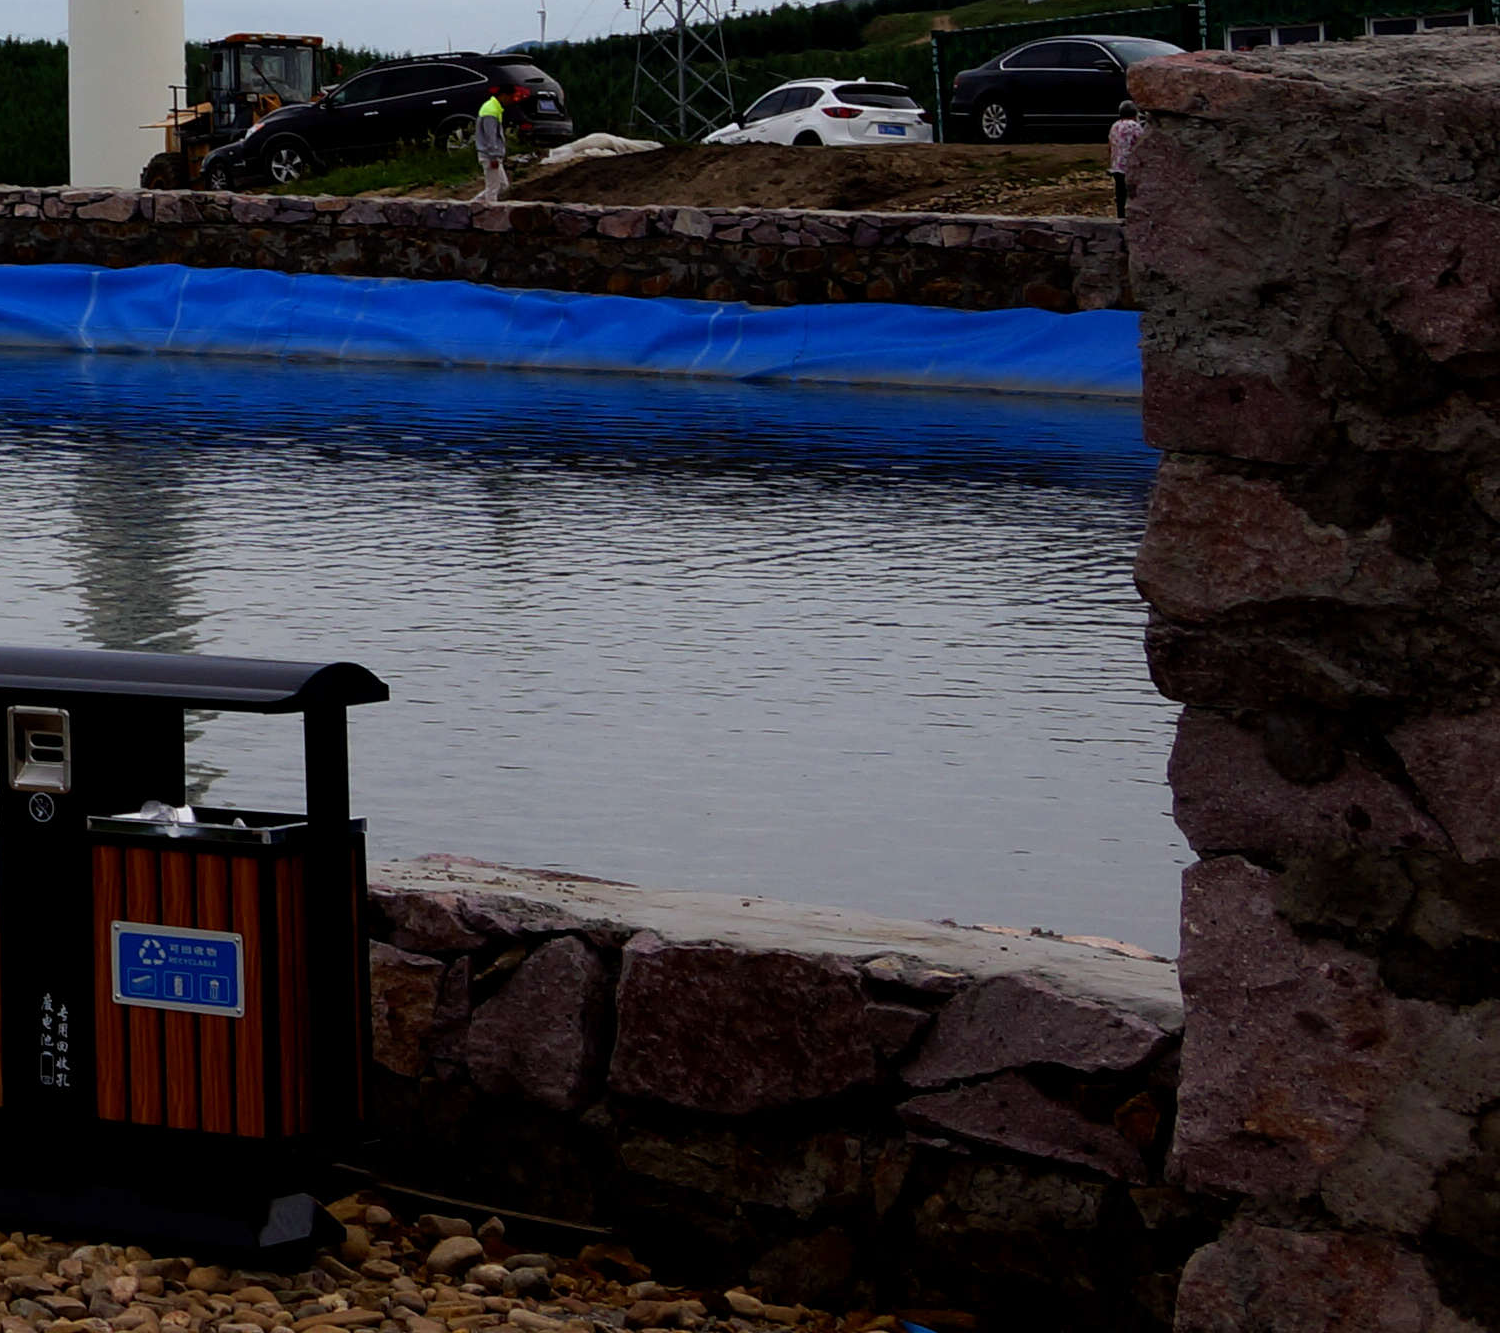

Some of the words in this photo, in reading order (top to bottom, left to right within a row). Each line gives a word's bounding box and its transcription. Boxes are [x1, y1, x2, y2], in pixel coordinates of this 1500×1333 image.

[169, 943, 218, 958] 可回收物
[168, 956, 217, 968] RECYCLABLE
